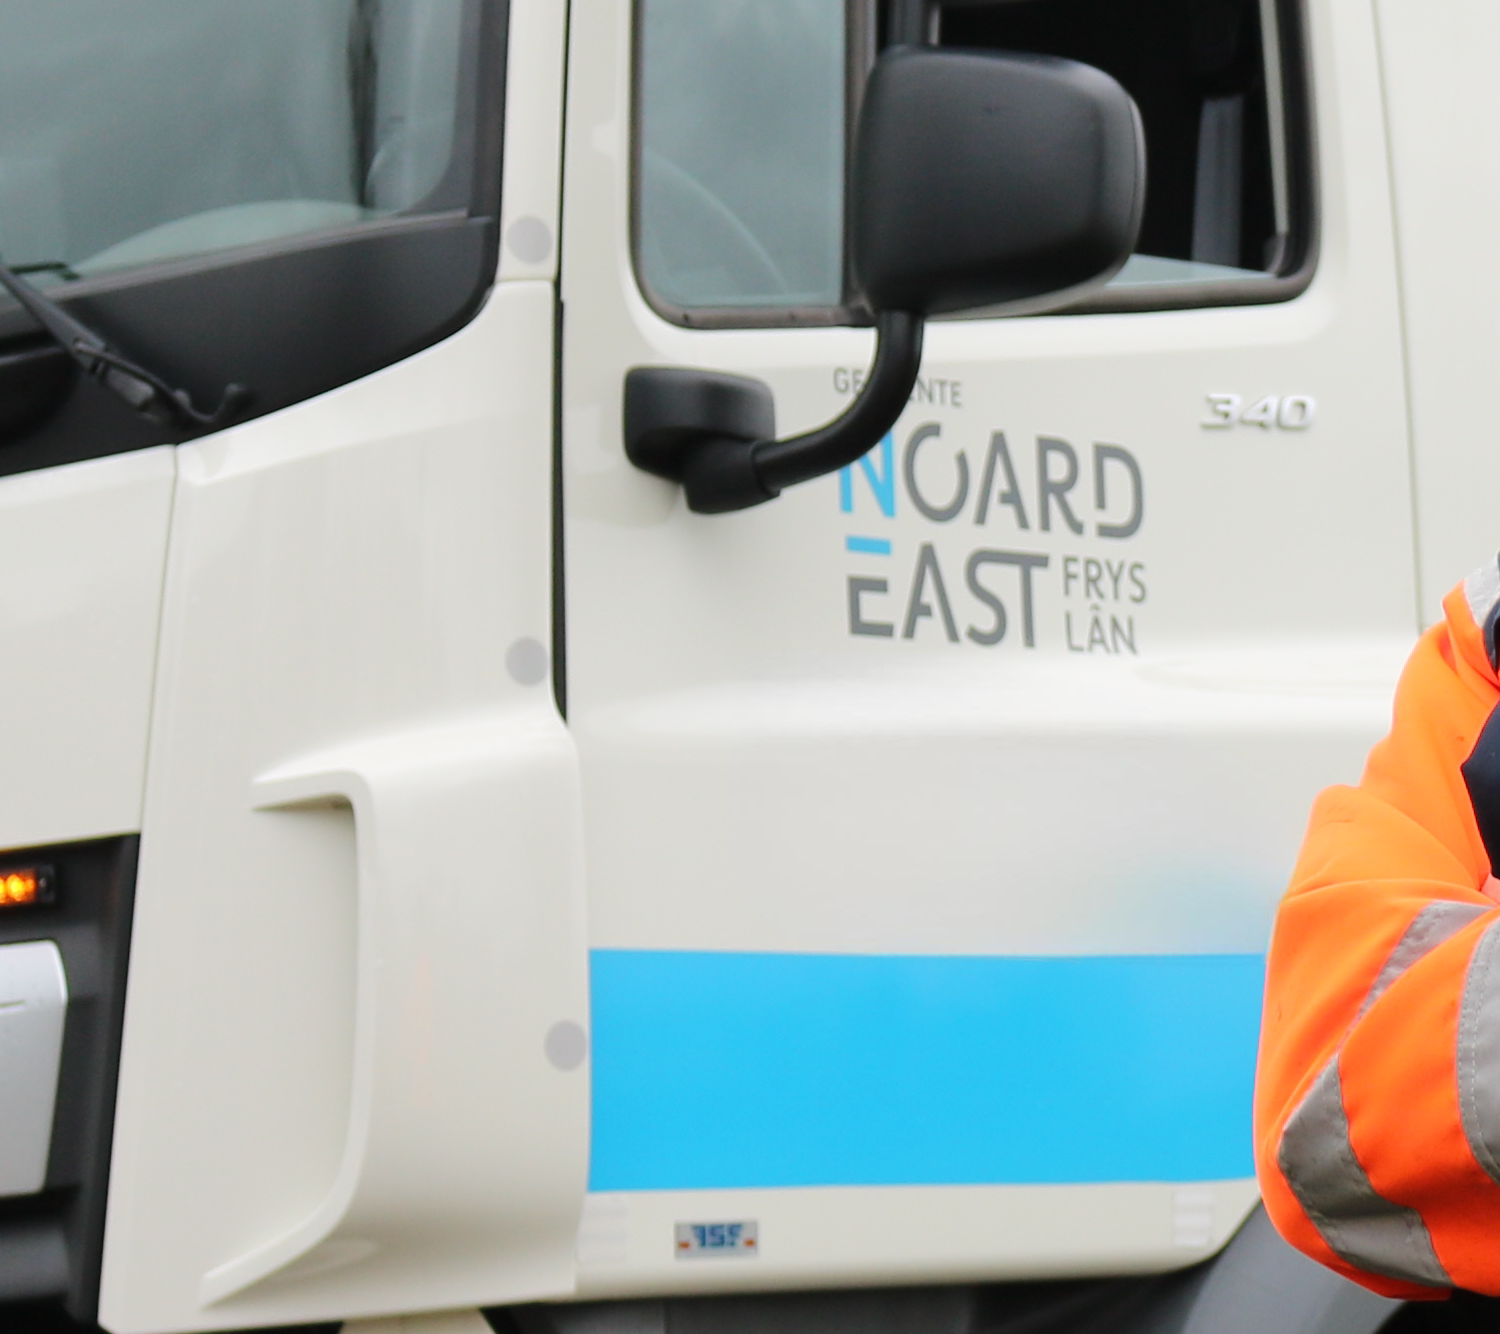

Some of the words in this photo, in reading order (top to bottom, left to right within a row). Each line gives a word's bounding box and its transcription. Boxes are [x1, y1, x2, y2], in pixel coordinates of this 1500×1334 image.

[833, 367, 963, 407] GENTE
[1200, 393, 1317, 431] 340
[838, 422, 1145, 538] NOARD
[846, 535, 1050, 649] EAST
[1062, 556, 1148, 604] FRYS
[1065, 604, 1139, 655] LÂN
